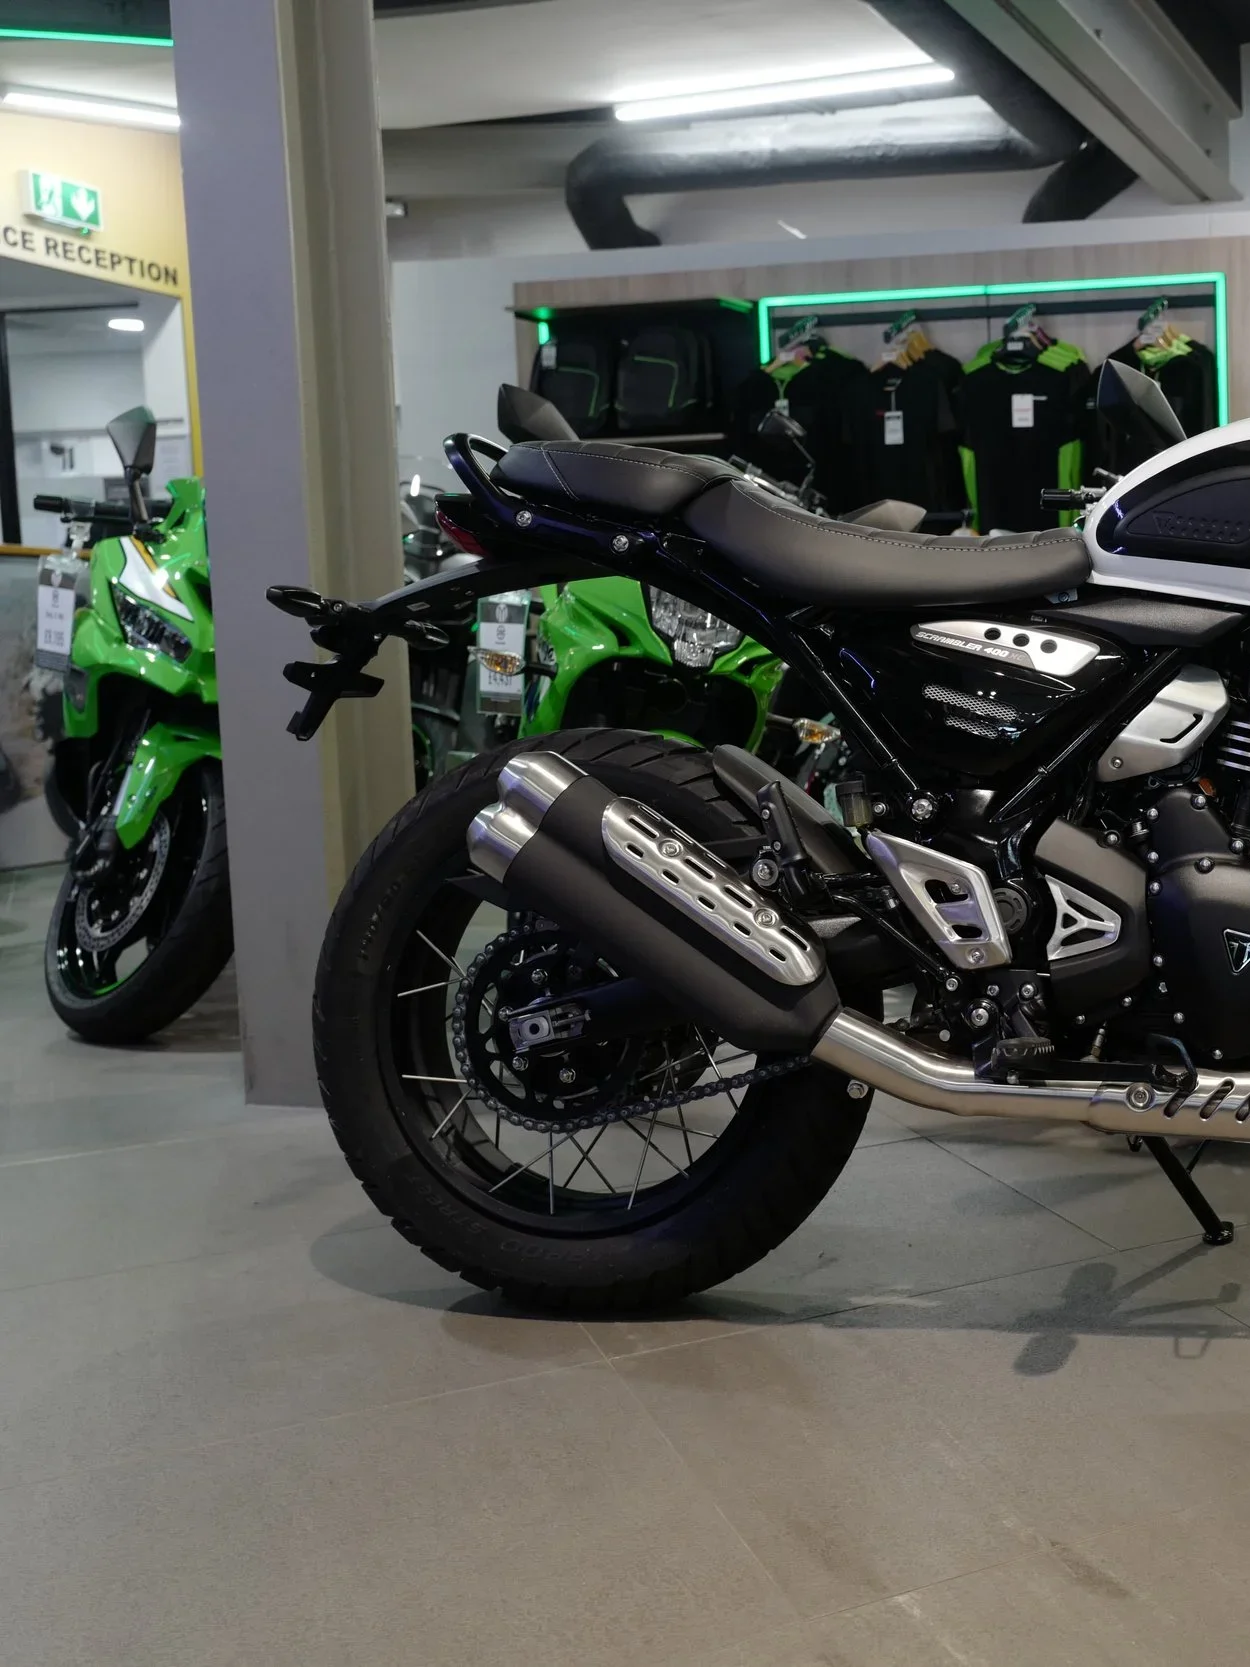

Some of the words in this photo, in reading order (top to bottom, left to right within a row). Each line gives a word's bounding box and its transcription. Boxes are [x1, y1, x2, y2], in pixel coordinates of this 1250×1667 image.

[0, 226, 36, 253] CE
[44, 236, 179, 286] RECEPTION
[915, 631, 983, 651] SCRAMBLER
[983, 647, 1010, 658] 400
[1008, 652, 1026, 661] XC
